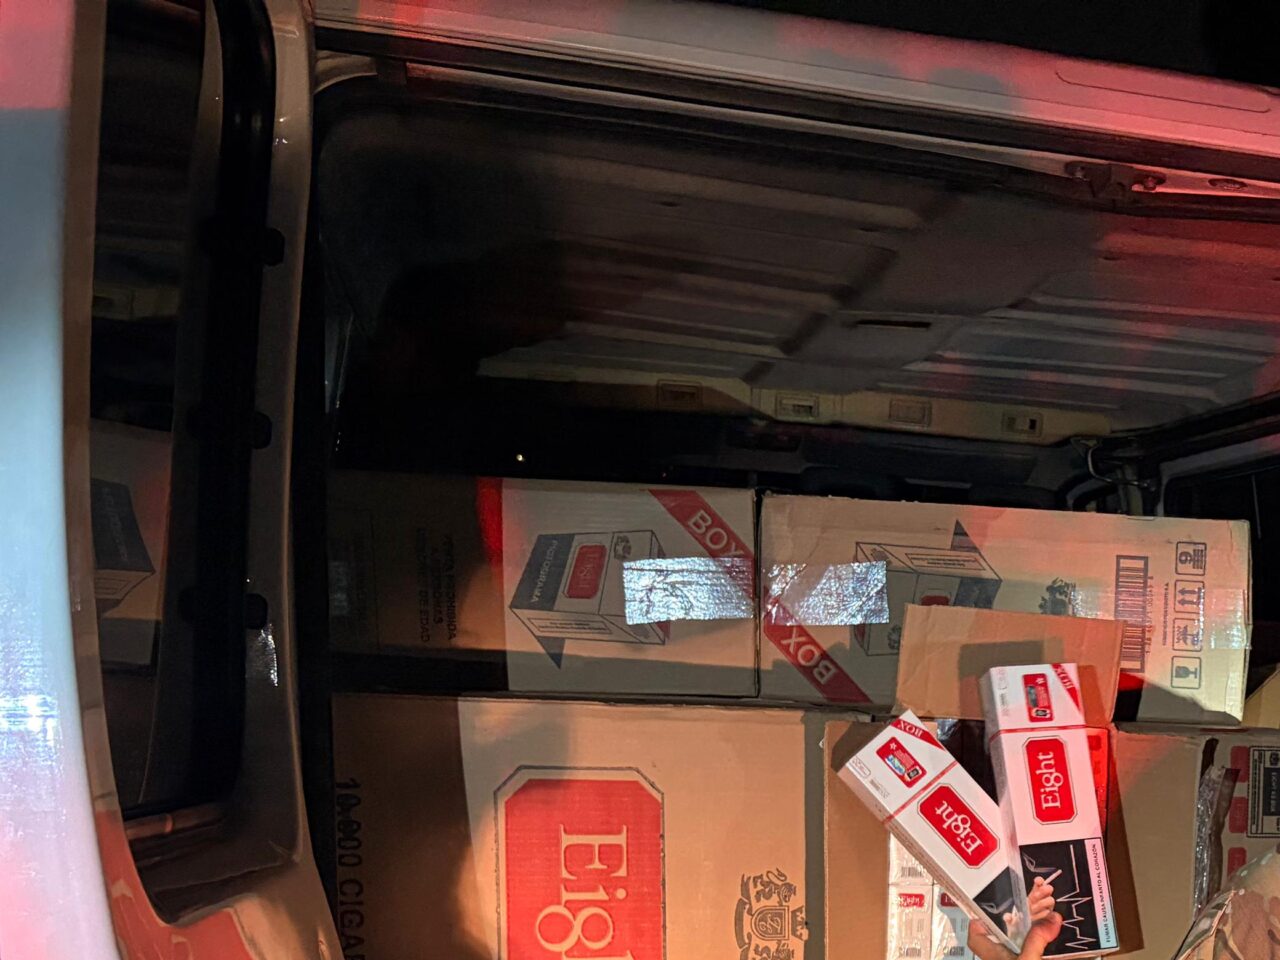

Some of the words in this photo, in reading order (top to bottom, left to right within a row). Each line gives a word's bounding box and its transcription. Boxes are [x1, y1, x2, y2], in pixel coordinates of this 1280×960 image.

[781, 632, 837, 684] BOX
[897, 719, 924, 738] BOX
[1041, 750, 1064, 811] Eight
[934, 800, 984, 856] Eight
